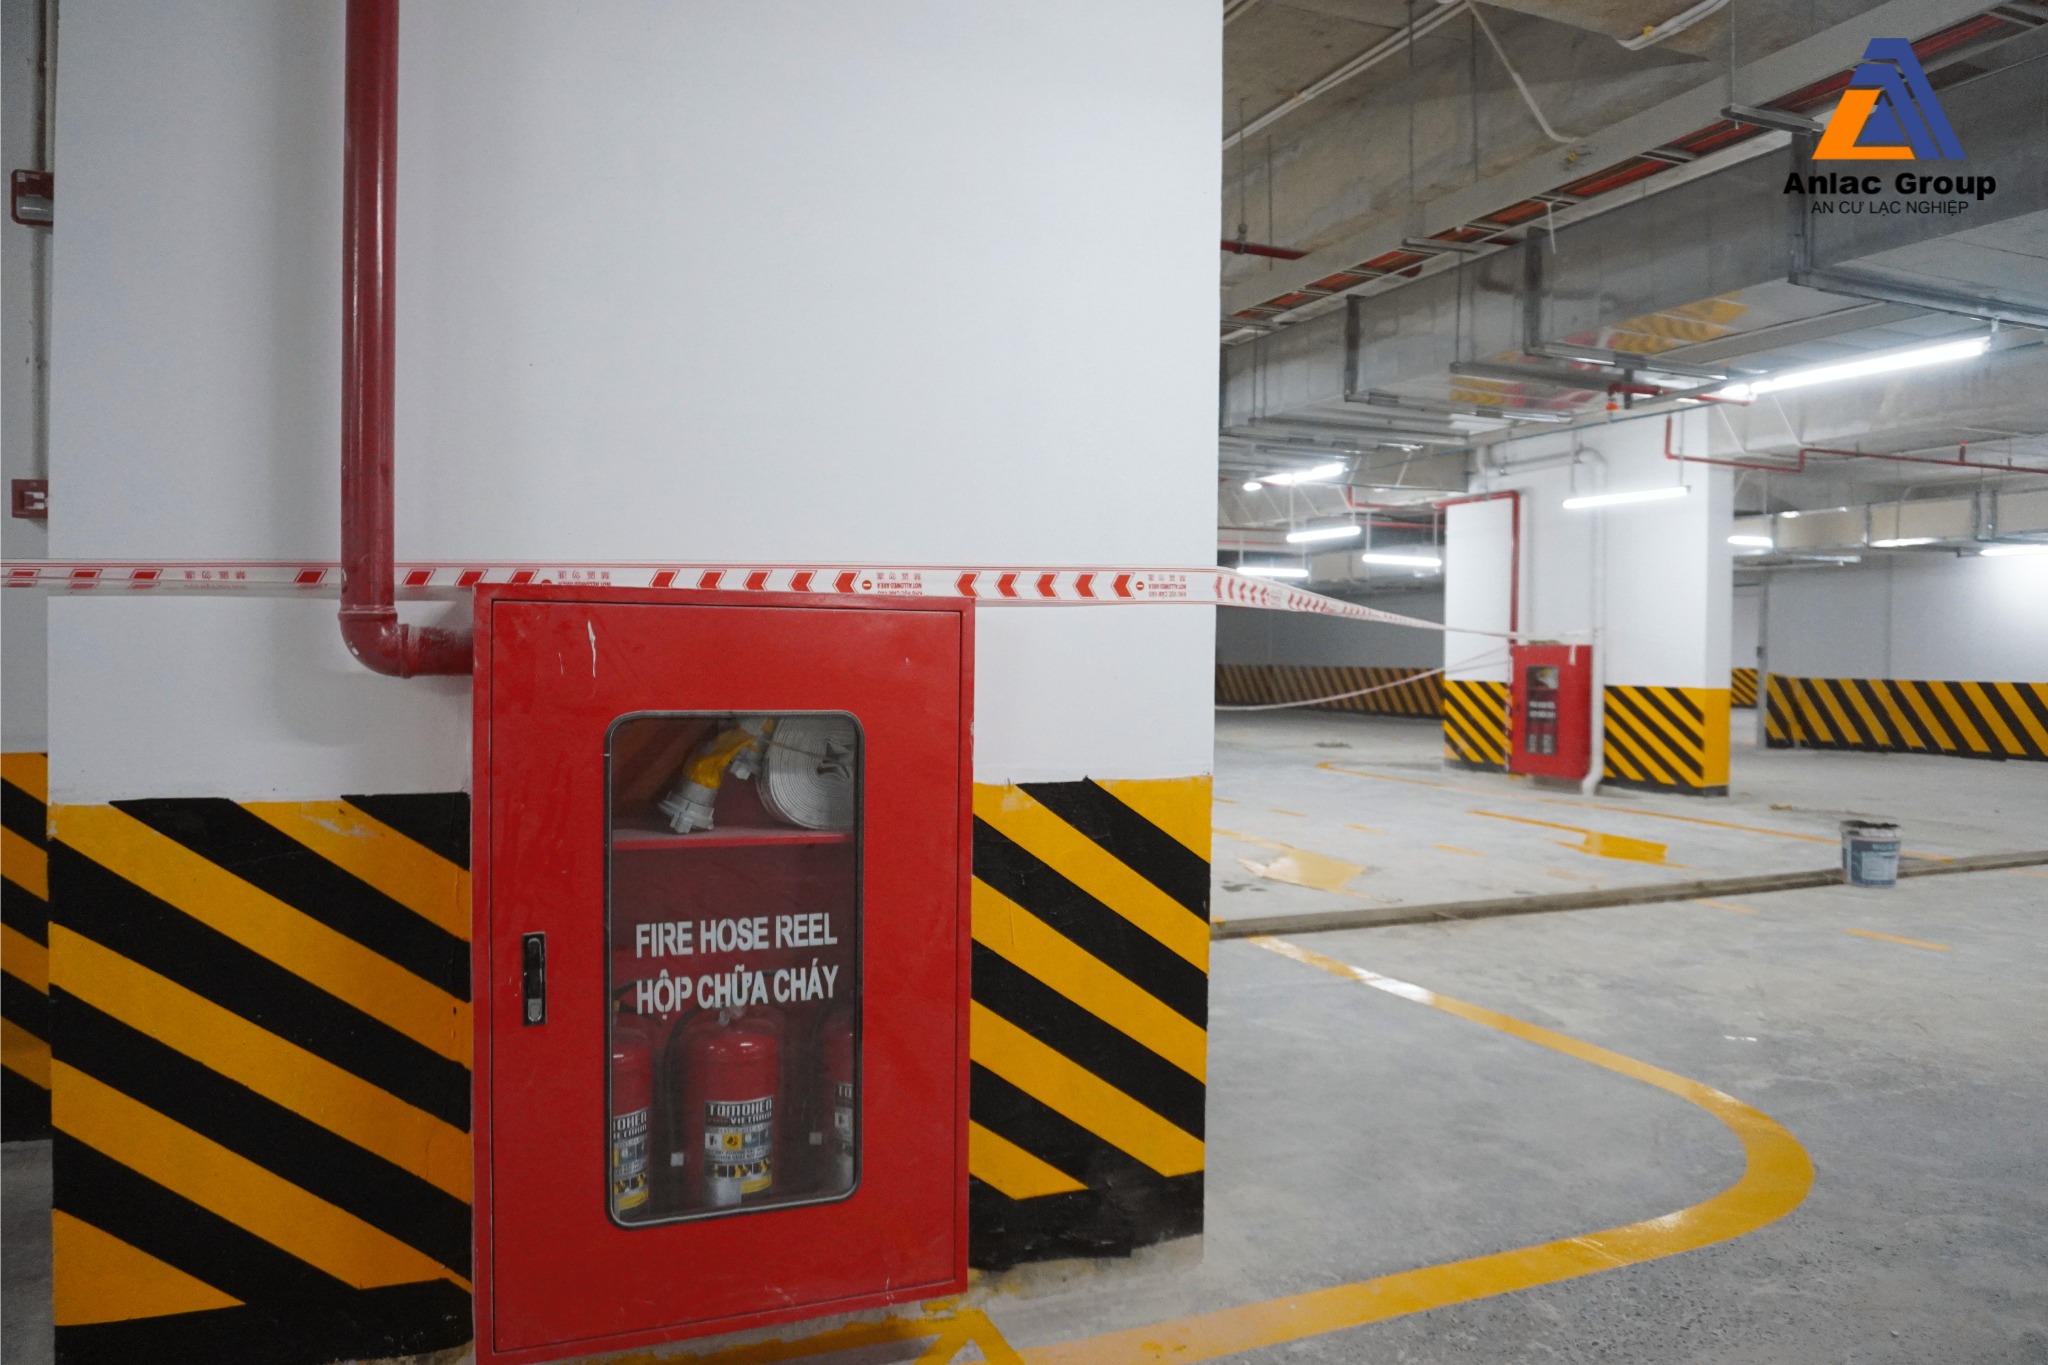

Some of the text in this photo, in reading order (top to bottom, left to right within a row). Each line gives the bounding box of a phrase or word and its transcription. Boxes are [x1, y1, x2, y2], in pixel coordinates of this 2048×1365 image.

[636, 912, 838, 959] FIRE HOSE REEL
[636, 957, 839, 1020] HỘP CHỮA CHÁY
